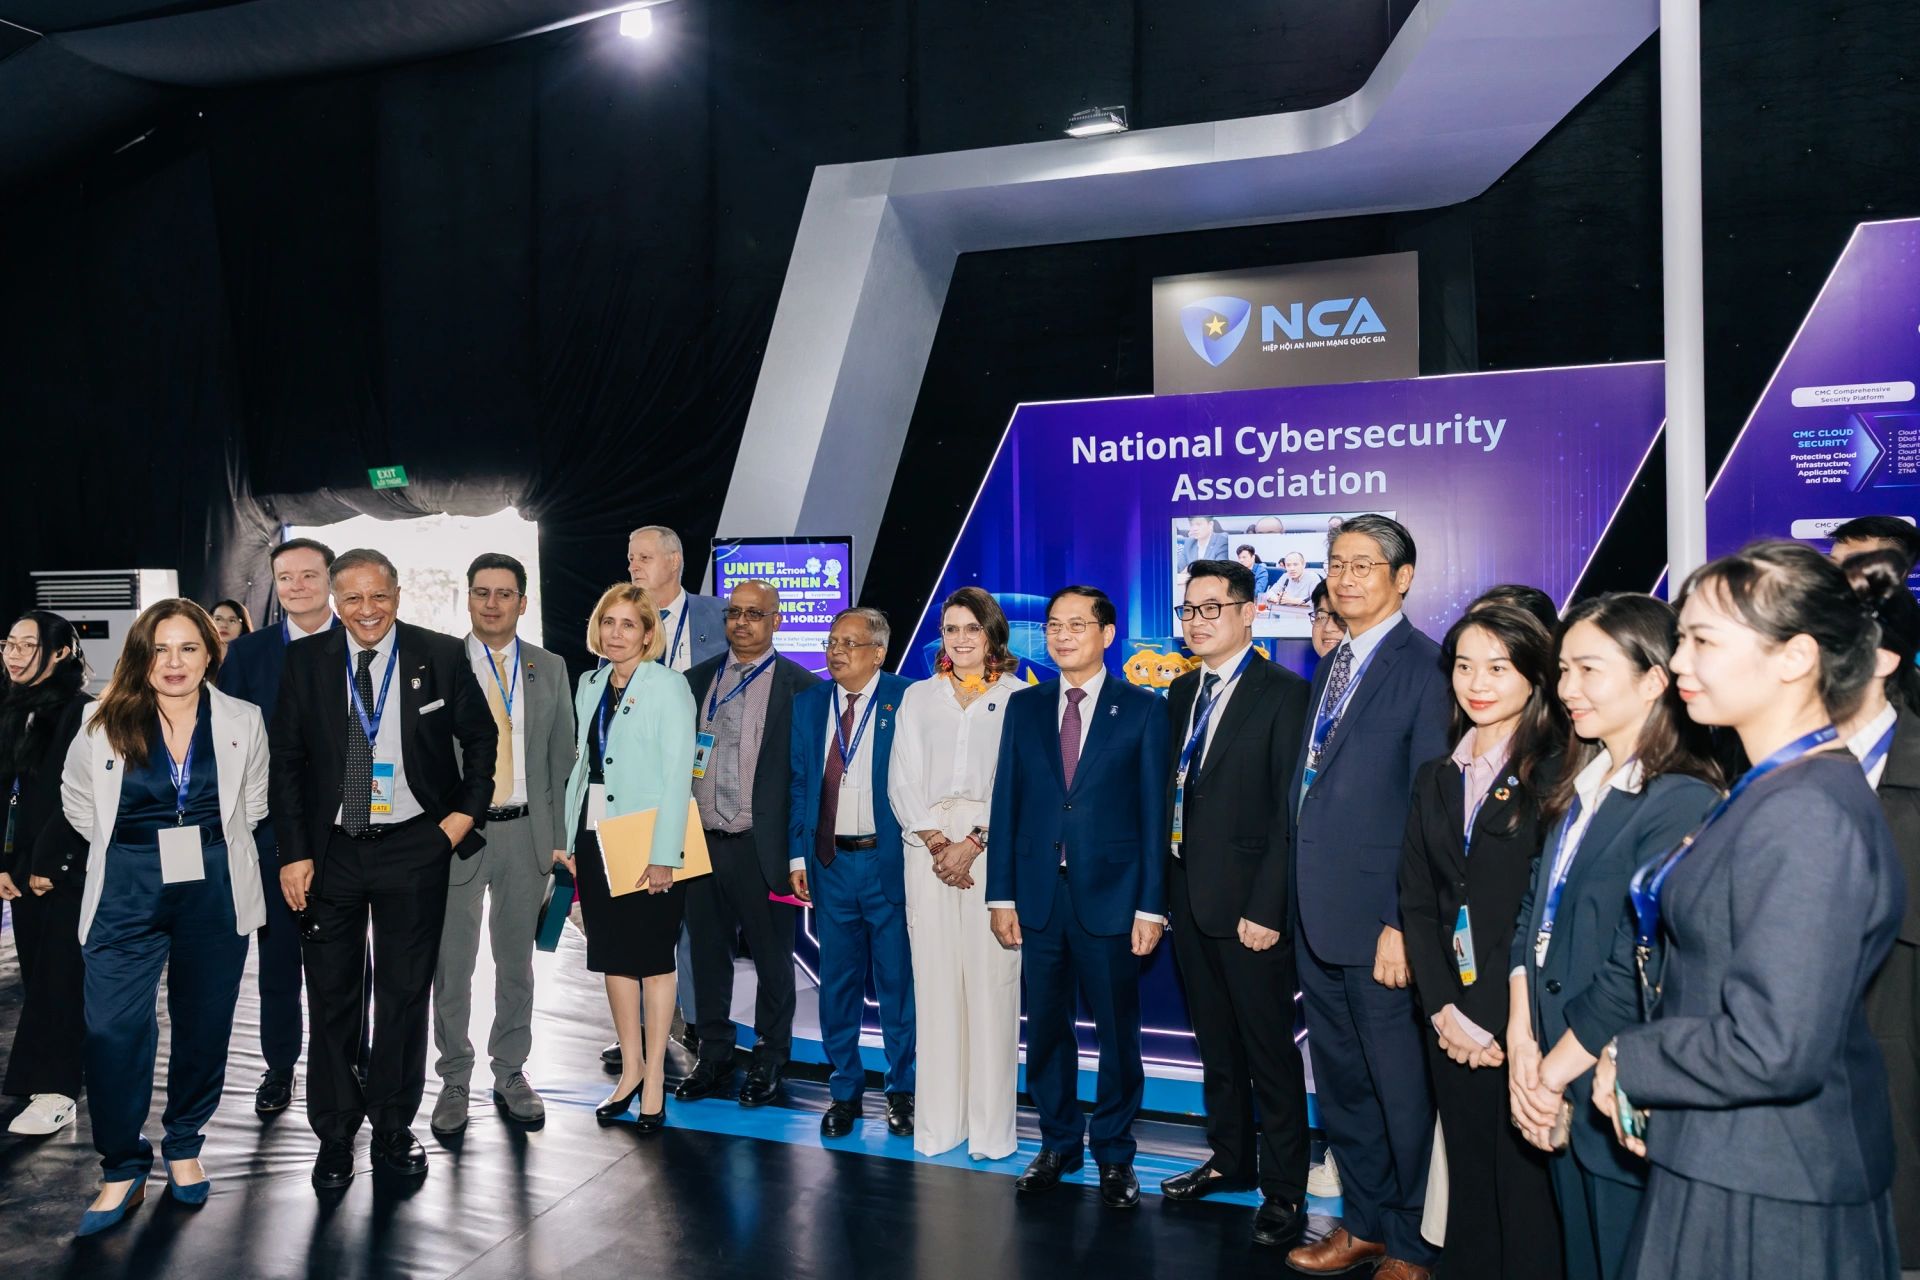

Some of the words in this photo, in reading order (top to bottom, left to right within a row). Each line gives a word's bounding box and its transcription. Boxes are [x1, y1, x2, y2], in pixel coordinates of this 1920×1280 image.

[1261, 297, 1387, 342] NCA
[1262, 343, 1279, 352] HIỆP
[1280, 342, 1293, 351] HỘI
[1306, 340, 1325, 348] NINH
[1326, 338, 1349, 347] MẠNG
[1350, 336, 1372, 345] QUỐC
[1373, 335, 1386, 343] GIA
[1833, 386, 1891, 395] Comprehensive
[1821, 396, 1851, 404] Security
[1793, 430, 1815, 438] CMC
[1818, 429, 1854, 437] CLOUD
[1072, 427, 1223, 464] National
[1234, 413, 1507, 463] Cybersecurity
[1798, 439, 1849, 448] SECURITY
[1790, 453, 1832, 461] Protecting
[377, 469, 396, 478] EXIT
[1797, 469, 1850, 477] Applications,
[1171, 465, 1387, 502] Association
[724, 562, 775, 575] UNITE
[724, 577, 820, 588] STGTHEN
[779, 601, 815, 612] NECT
[790, 614, 836, 623] HORIZO
